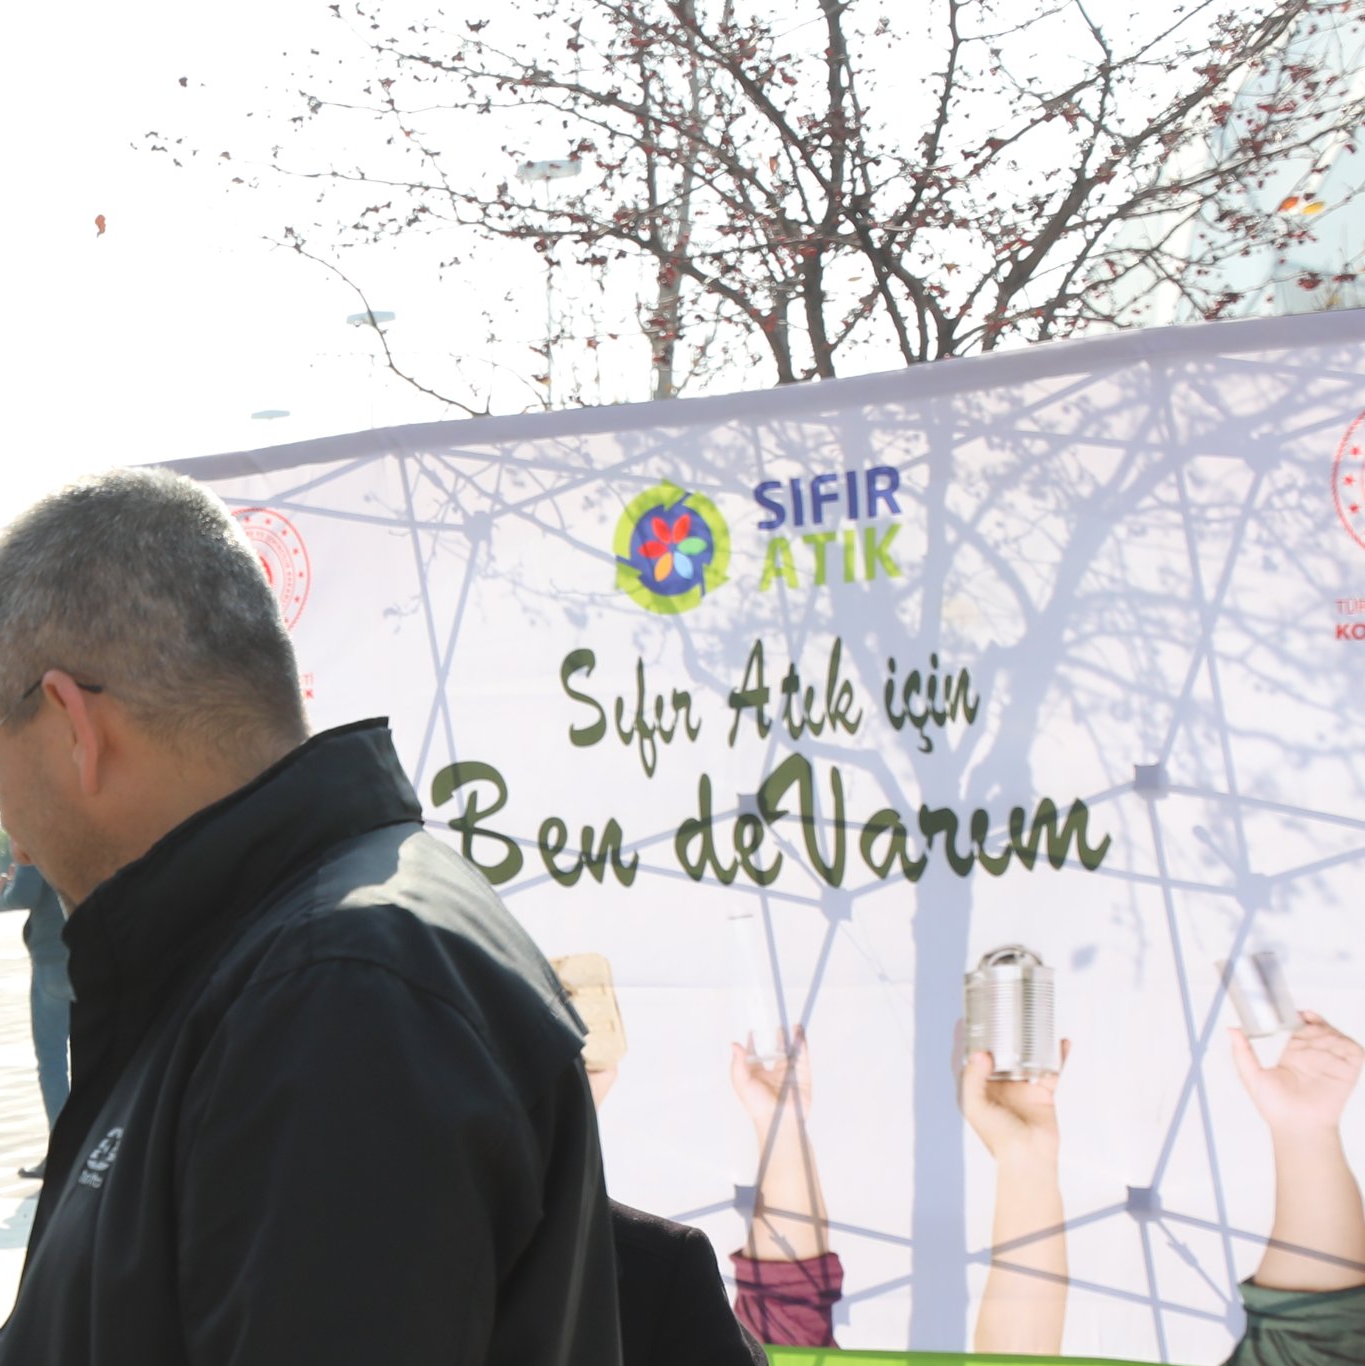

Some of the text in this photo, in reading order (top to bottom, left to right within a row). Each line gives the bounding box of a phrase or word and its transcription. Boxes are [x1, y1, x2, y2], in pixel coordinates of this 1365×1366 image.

[754, 464, 901, 531] SIFIR
[759, 522, 903, 592] ATIK
[561, 636, 981, 780] Sıfır Atık için
[431, 759, 640, 886] Ben
